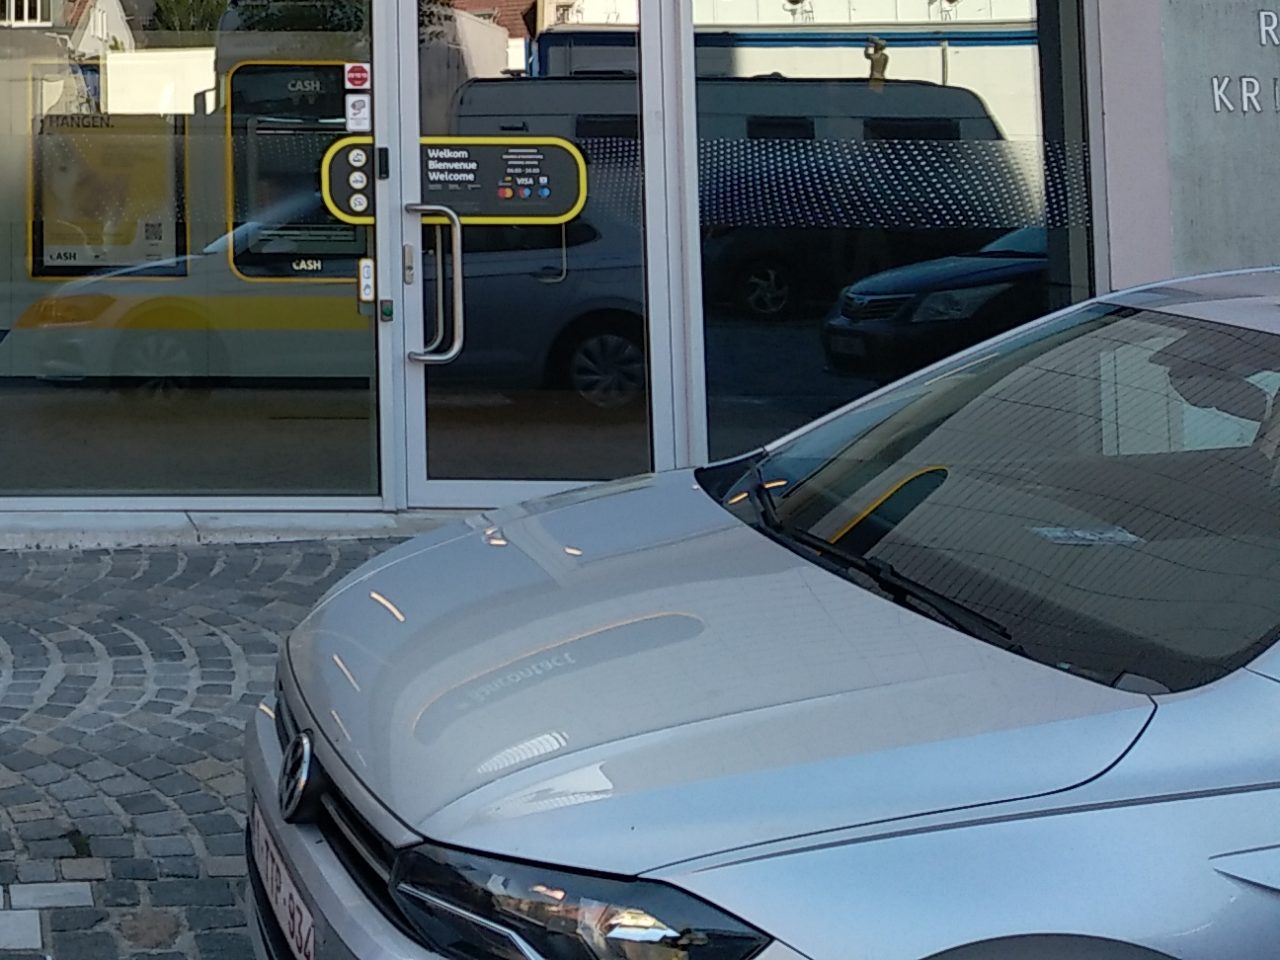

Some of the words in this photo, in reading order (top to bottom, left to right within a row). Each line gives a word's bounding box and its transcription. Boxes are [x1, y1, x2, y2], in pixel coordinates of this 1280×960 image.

[288, 80, 320, 91] CASH
[427, 148, 469, 159] Welkom
[428, 159, 478, 170] Bienvenue
[428, 171, 475, 182] Welcome
[515, 177, 534, 185] VISA
[292, 259, 322, 271] CASH
